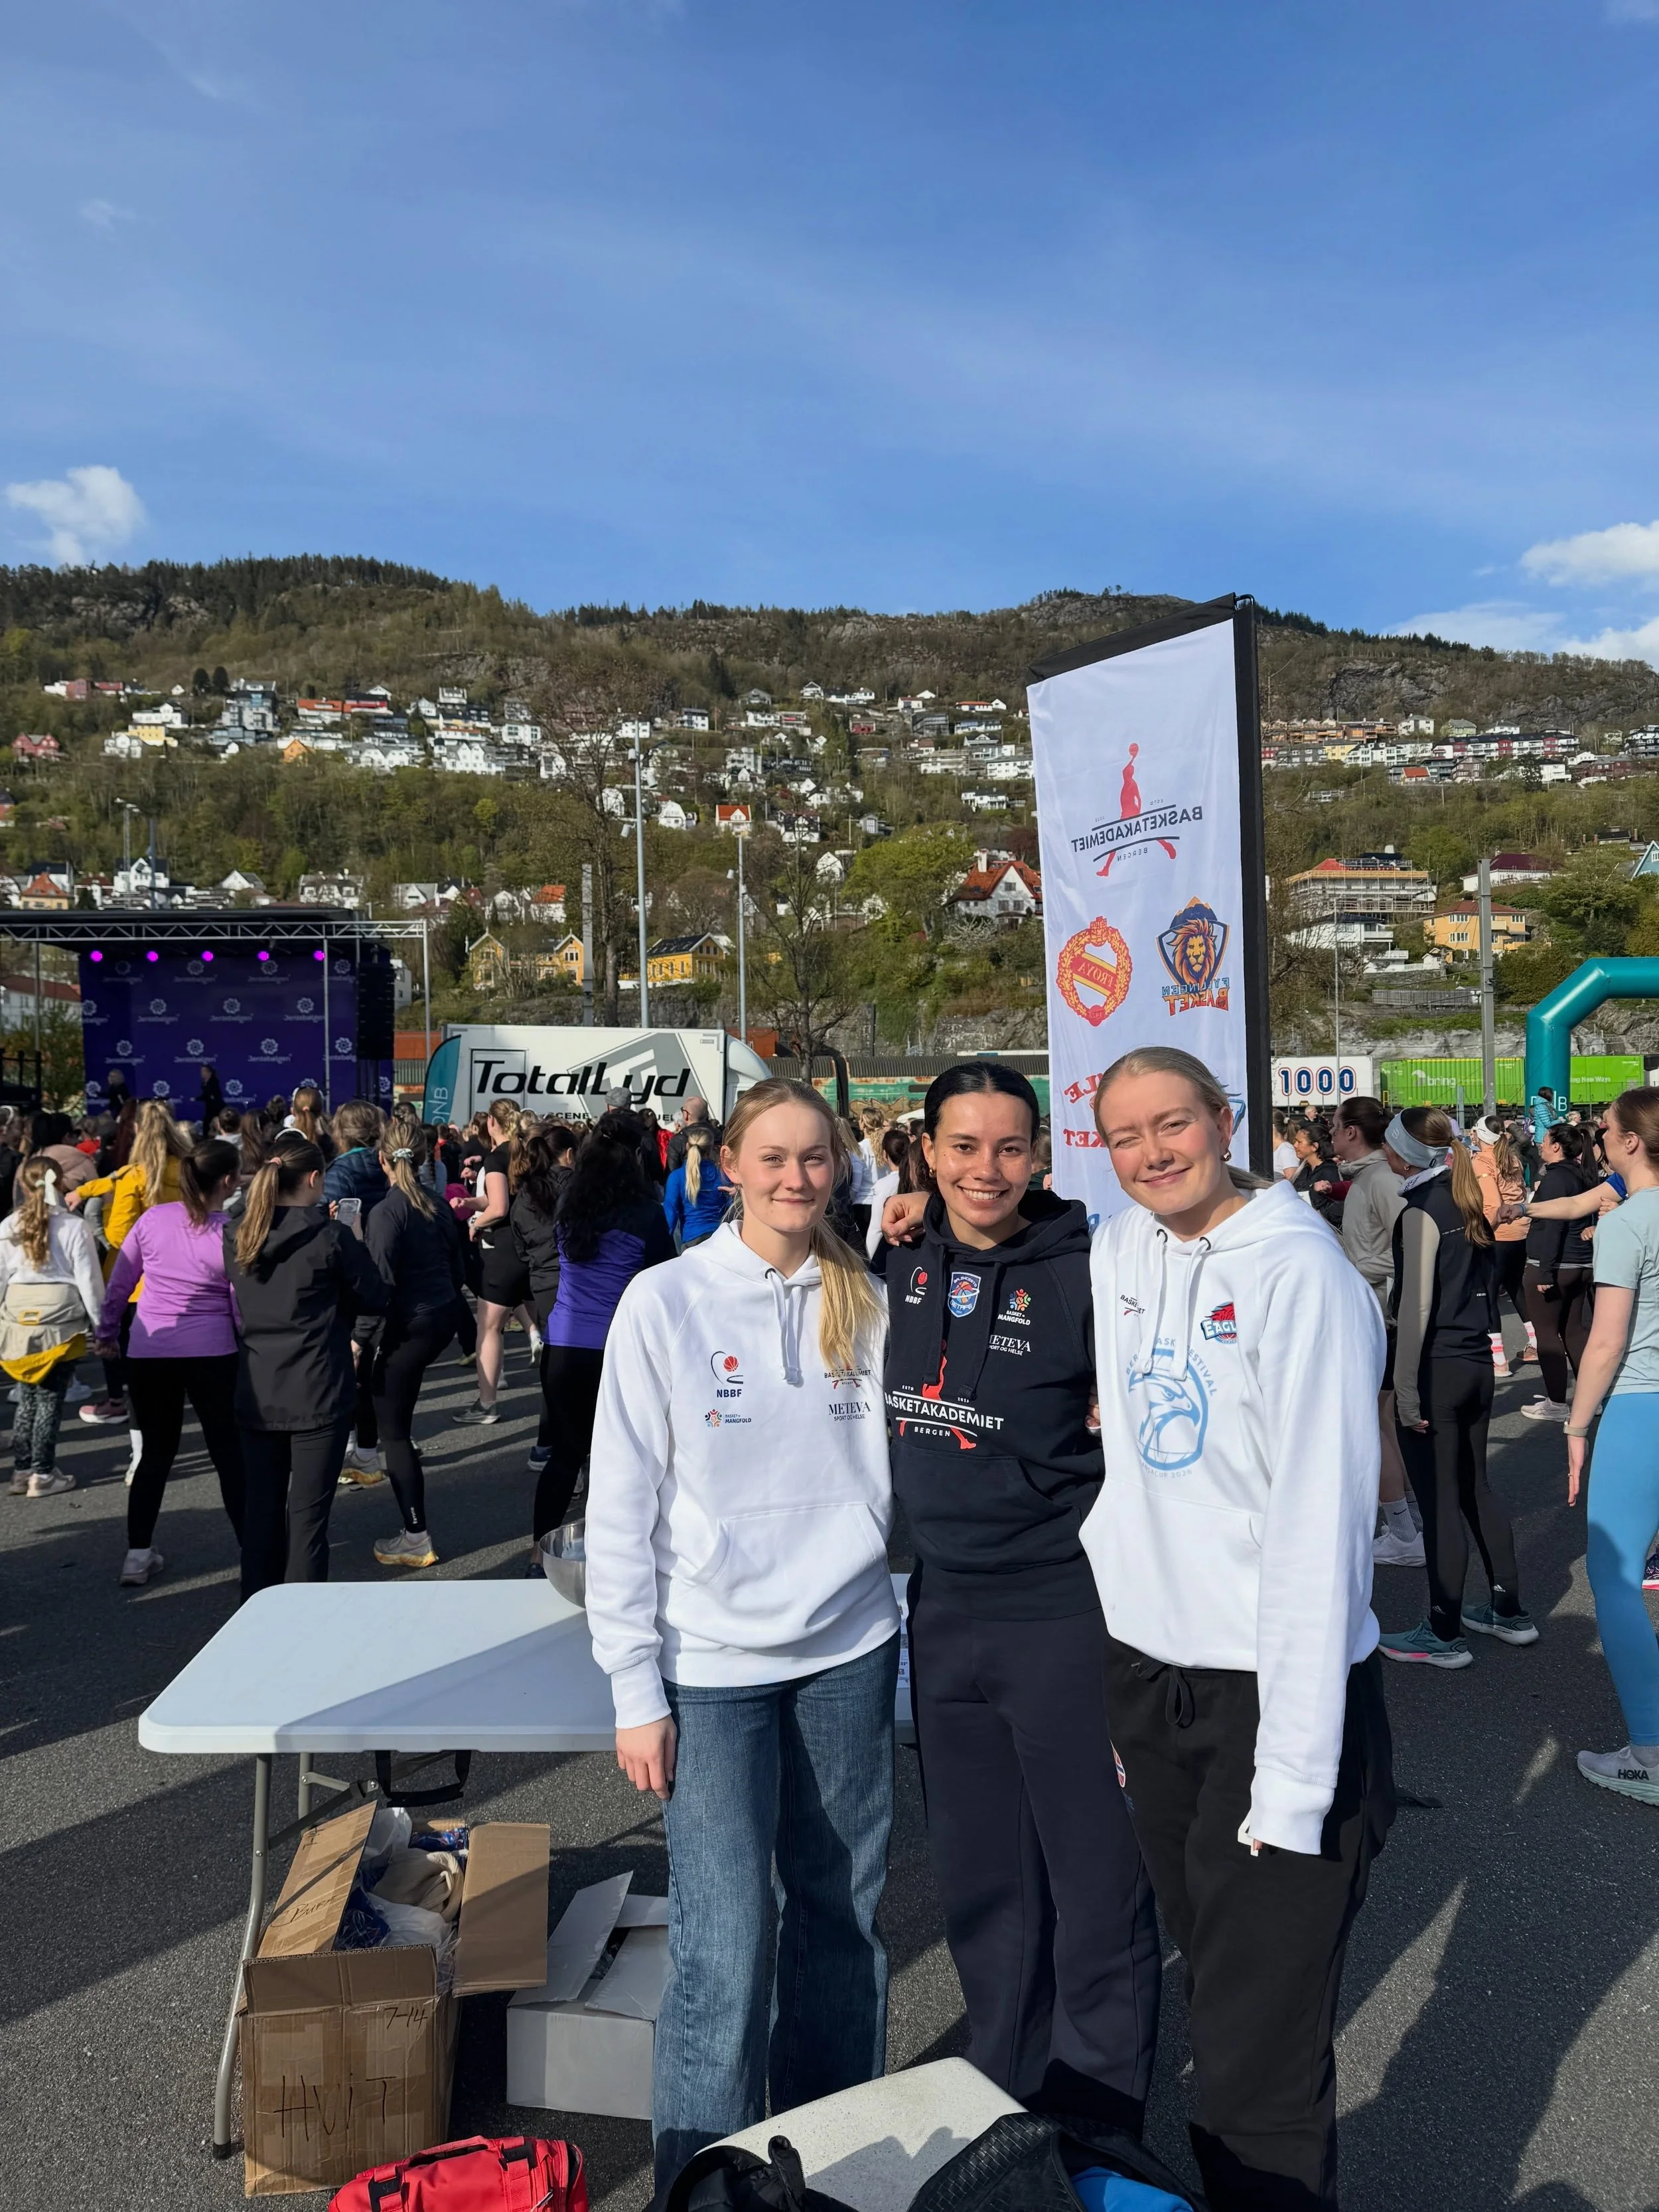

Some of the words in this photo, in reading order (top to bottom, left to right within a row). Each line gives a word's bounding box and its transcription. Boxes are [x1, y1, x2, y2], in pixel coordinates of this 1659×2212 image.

[474, 1060, 691, 1104] TotalLyd
[1278, 1066, 1356, 1096] 1000
[1427, 1075, 1456, 1088] bring
[997, 1314, 1031, 1325] MANGFOLD
[1188, 1347, 1217, 1396] ESTIVAL
[717, 1389, 742, 1398] NBBF
[828, 1402, 871, 1416] METEVA
[914, 1426, 951, 1437] BERGEN
[1618, 1769, 1650, 1781] HOKA
[384, 2007, 428, 2030] 7-14
